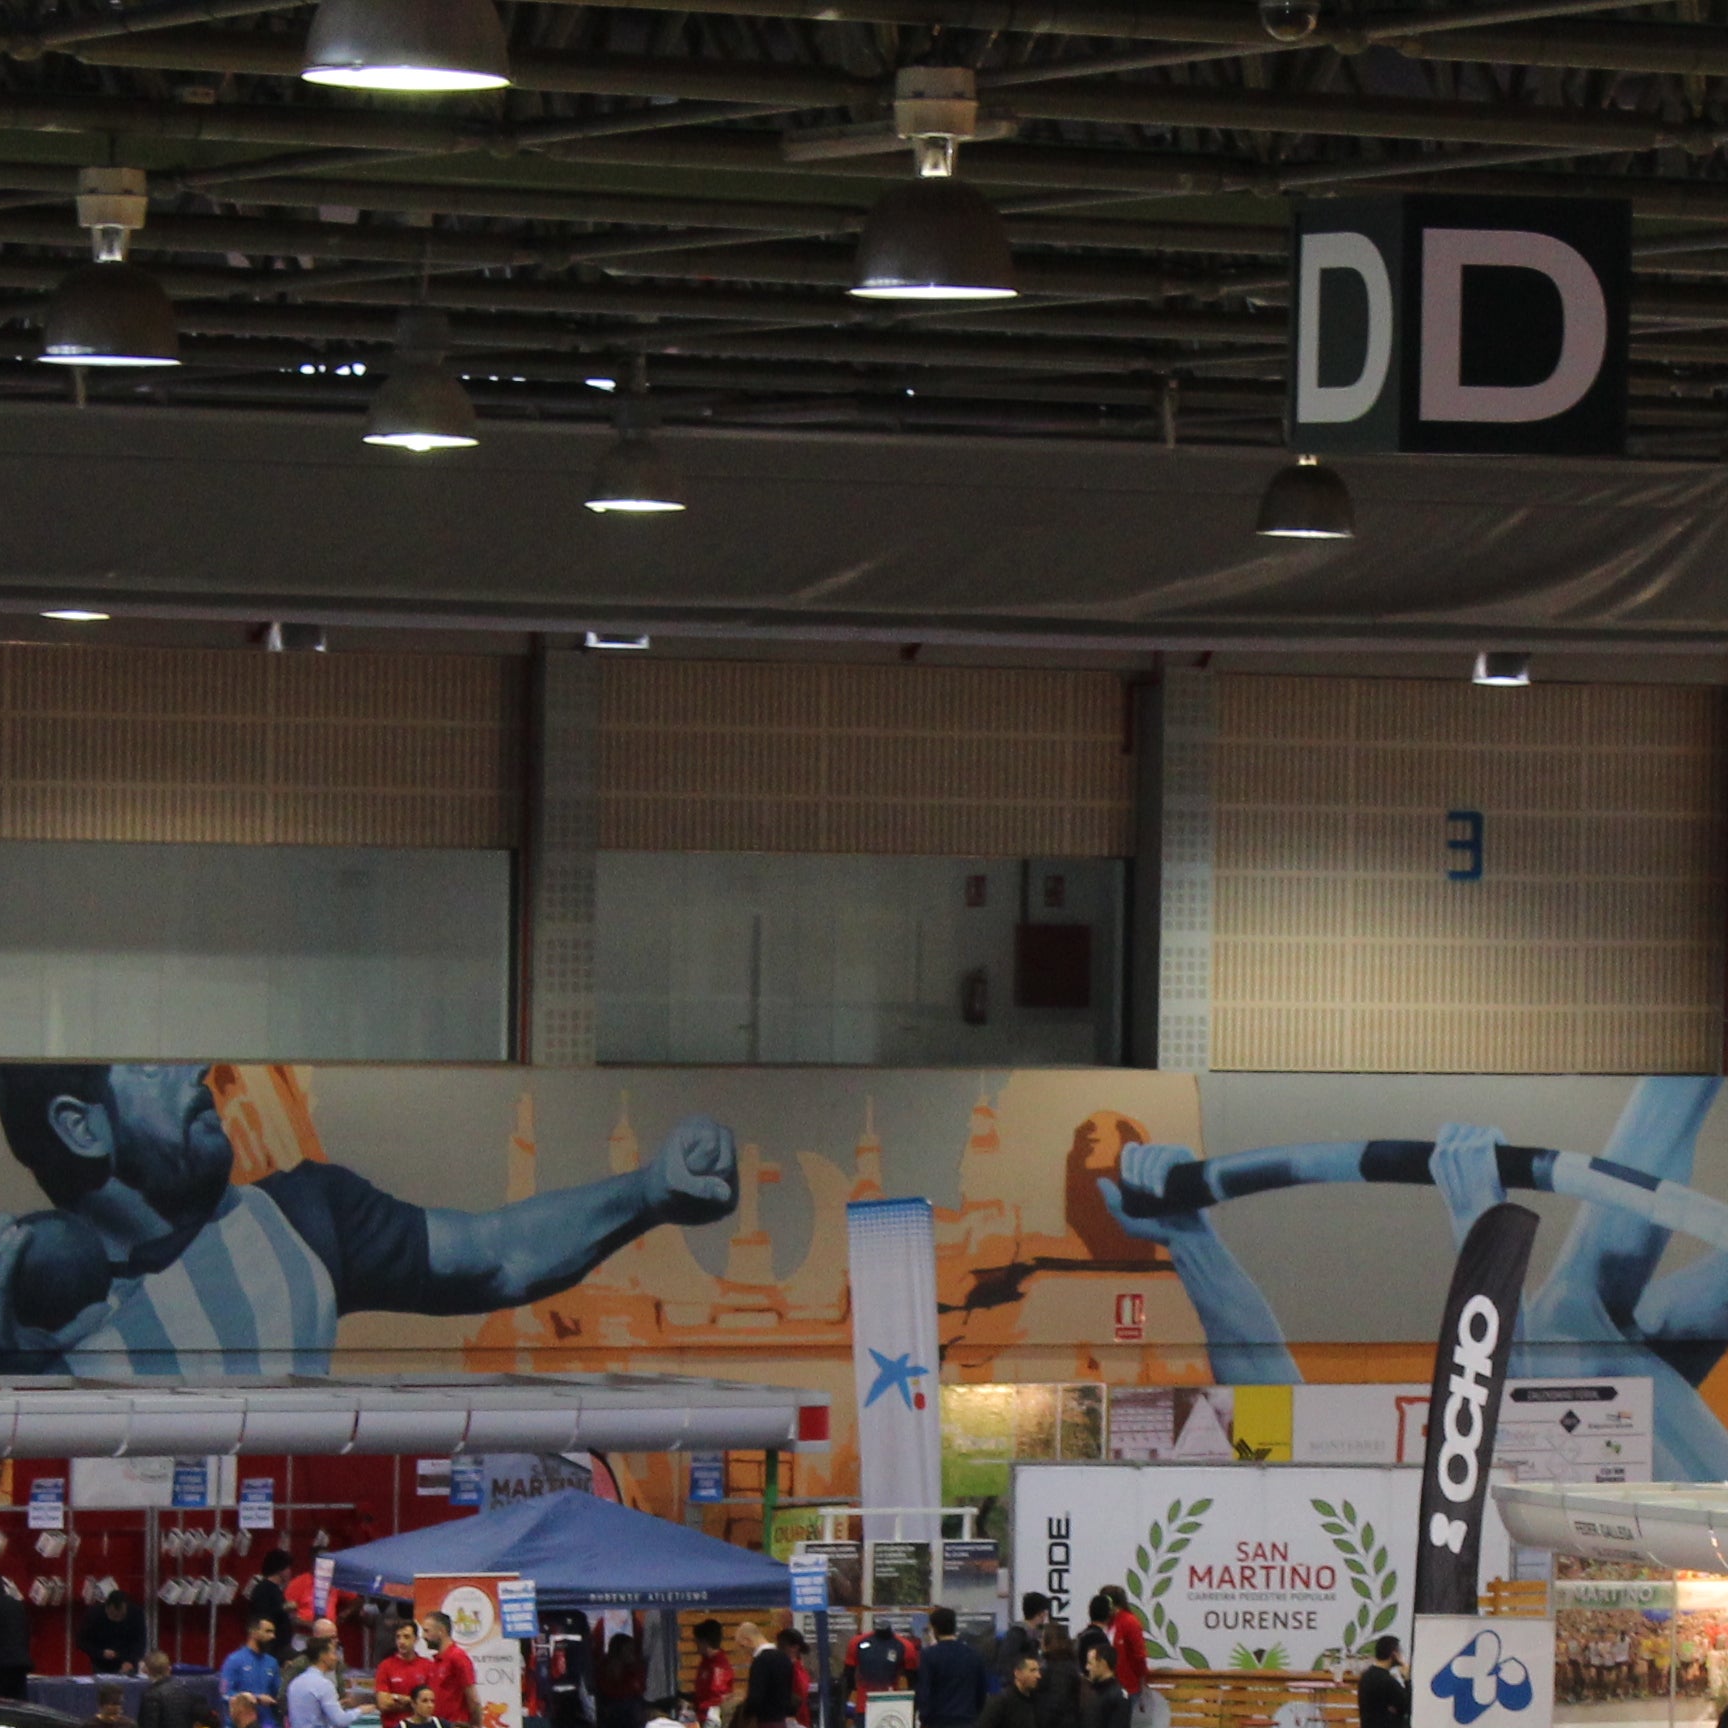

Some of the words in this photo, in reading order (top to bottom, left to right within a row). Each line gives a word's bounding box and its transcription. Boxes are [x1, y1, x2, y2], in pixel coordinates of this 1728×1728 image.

[1297, 231, 1393, 424] D
[1419, 228, 1608, 423] D
[1438, 1294, 1499, 1503] OCHO
[1048, 1515, 1071, 1632] RADE
[1188, 1562, 1336, 1590] MARTIÑO
[1237, 1541, 1288, 1563] SAN
[1204, 1610, 1317, 1630] OURENSE
[1290, 1593, 1336, 1601] POPULAR
